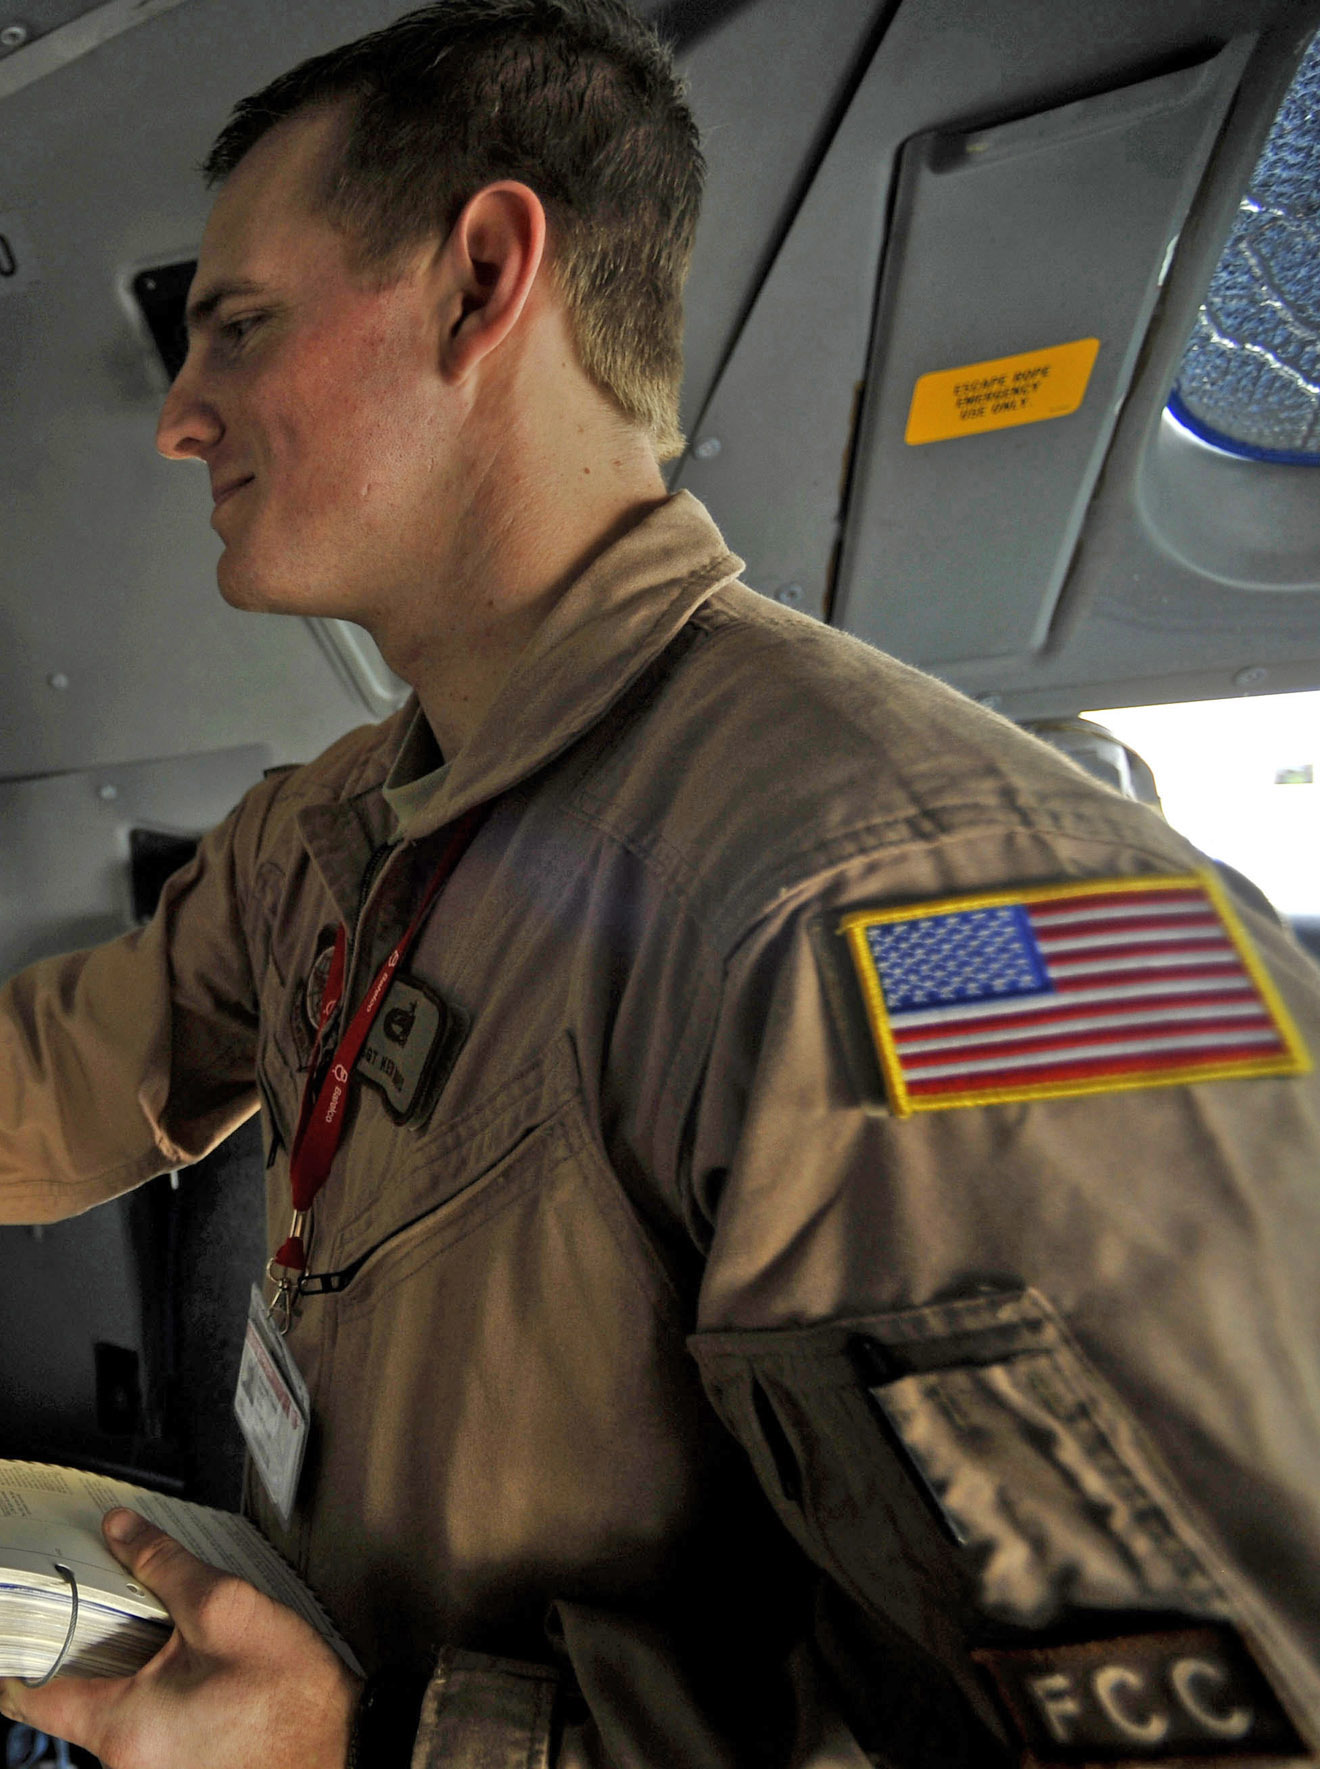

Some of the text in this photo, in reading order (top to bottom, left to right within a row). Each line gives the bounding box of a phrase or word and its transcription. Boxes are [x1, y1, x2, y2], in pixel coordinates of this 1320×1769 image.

[954, 376, 1006, 395] ESCAPE
[956, 382, 1042, 409] EMERGENCY
[960, 406, 985, 421] USE
[325, 1086, 342, 1123] Batelco
